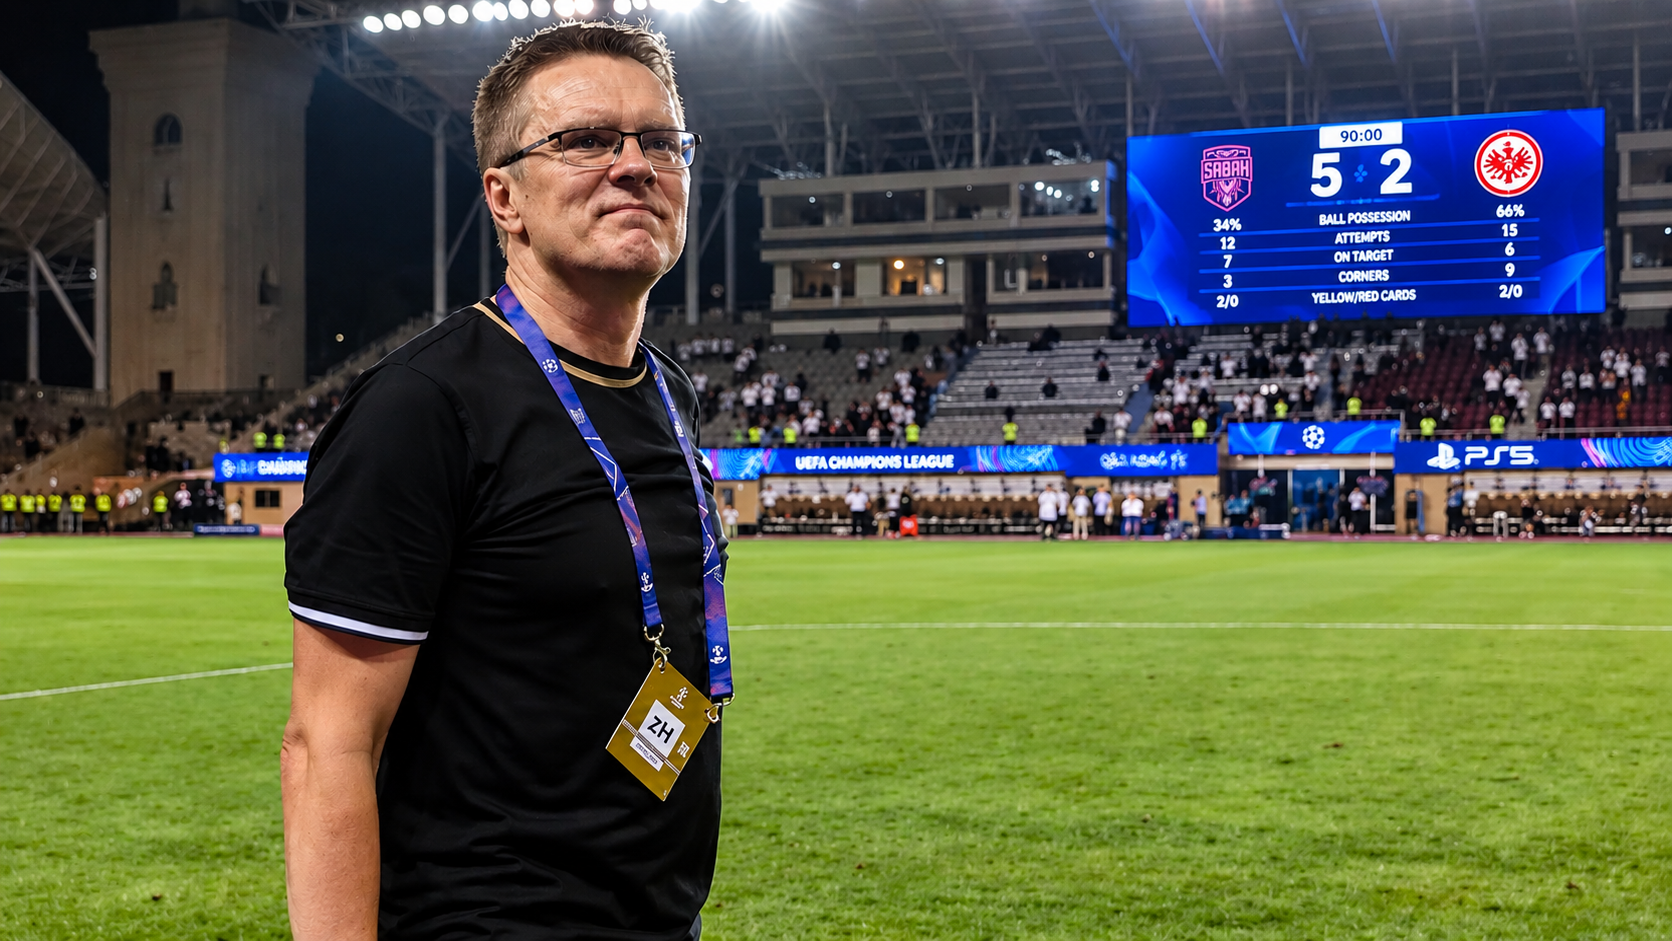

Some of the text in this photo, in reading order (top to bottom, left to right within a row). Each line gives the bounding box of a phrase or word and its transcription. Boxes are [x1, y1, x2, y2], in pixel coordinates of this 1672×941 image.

[1340, 128, 1382, 143] 90:00
[1204, 160, 1249, 179] SABAH
[1311, 152, 1342, 197] 5
[1381, 149, 1412, 194] 2
[1319, 210, 1410, 225] BALL POSSESSION
[1496, 204, 1524, 217] 66%
[1214, 218, 1241, 231] 34%
[1502, 224, 1517, 236] 15
[1220, 237, 1235, 249] 12
[1335, 230, 1390, 244] ATTEMPTS
[1334, 249, 1393, 262] ON TARGET
[1505, 242, 1514, 256] 6
[1224, 255, 1232, 268] 7
[1339, 270, 1389, 282] CORNERS
[1505, 263, 1515, 277] 9
[1223, 275, 1232, 288] 3
[1312, 289, 1416, 303] YELLOW/RED CARDS
[1499, 284, 1522, 298] 2/0
[1217, 295, 1238, 309] 2/0
[796, 455, 954, 470] UEFA CHAMPIONS LEAGUE
[1465, 446, 1534, 465] PS5
[647, 715, 675, 744] ZH
